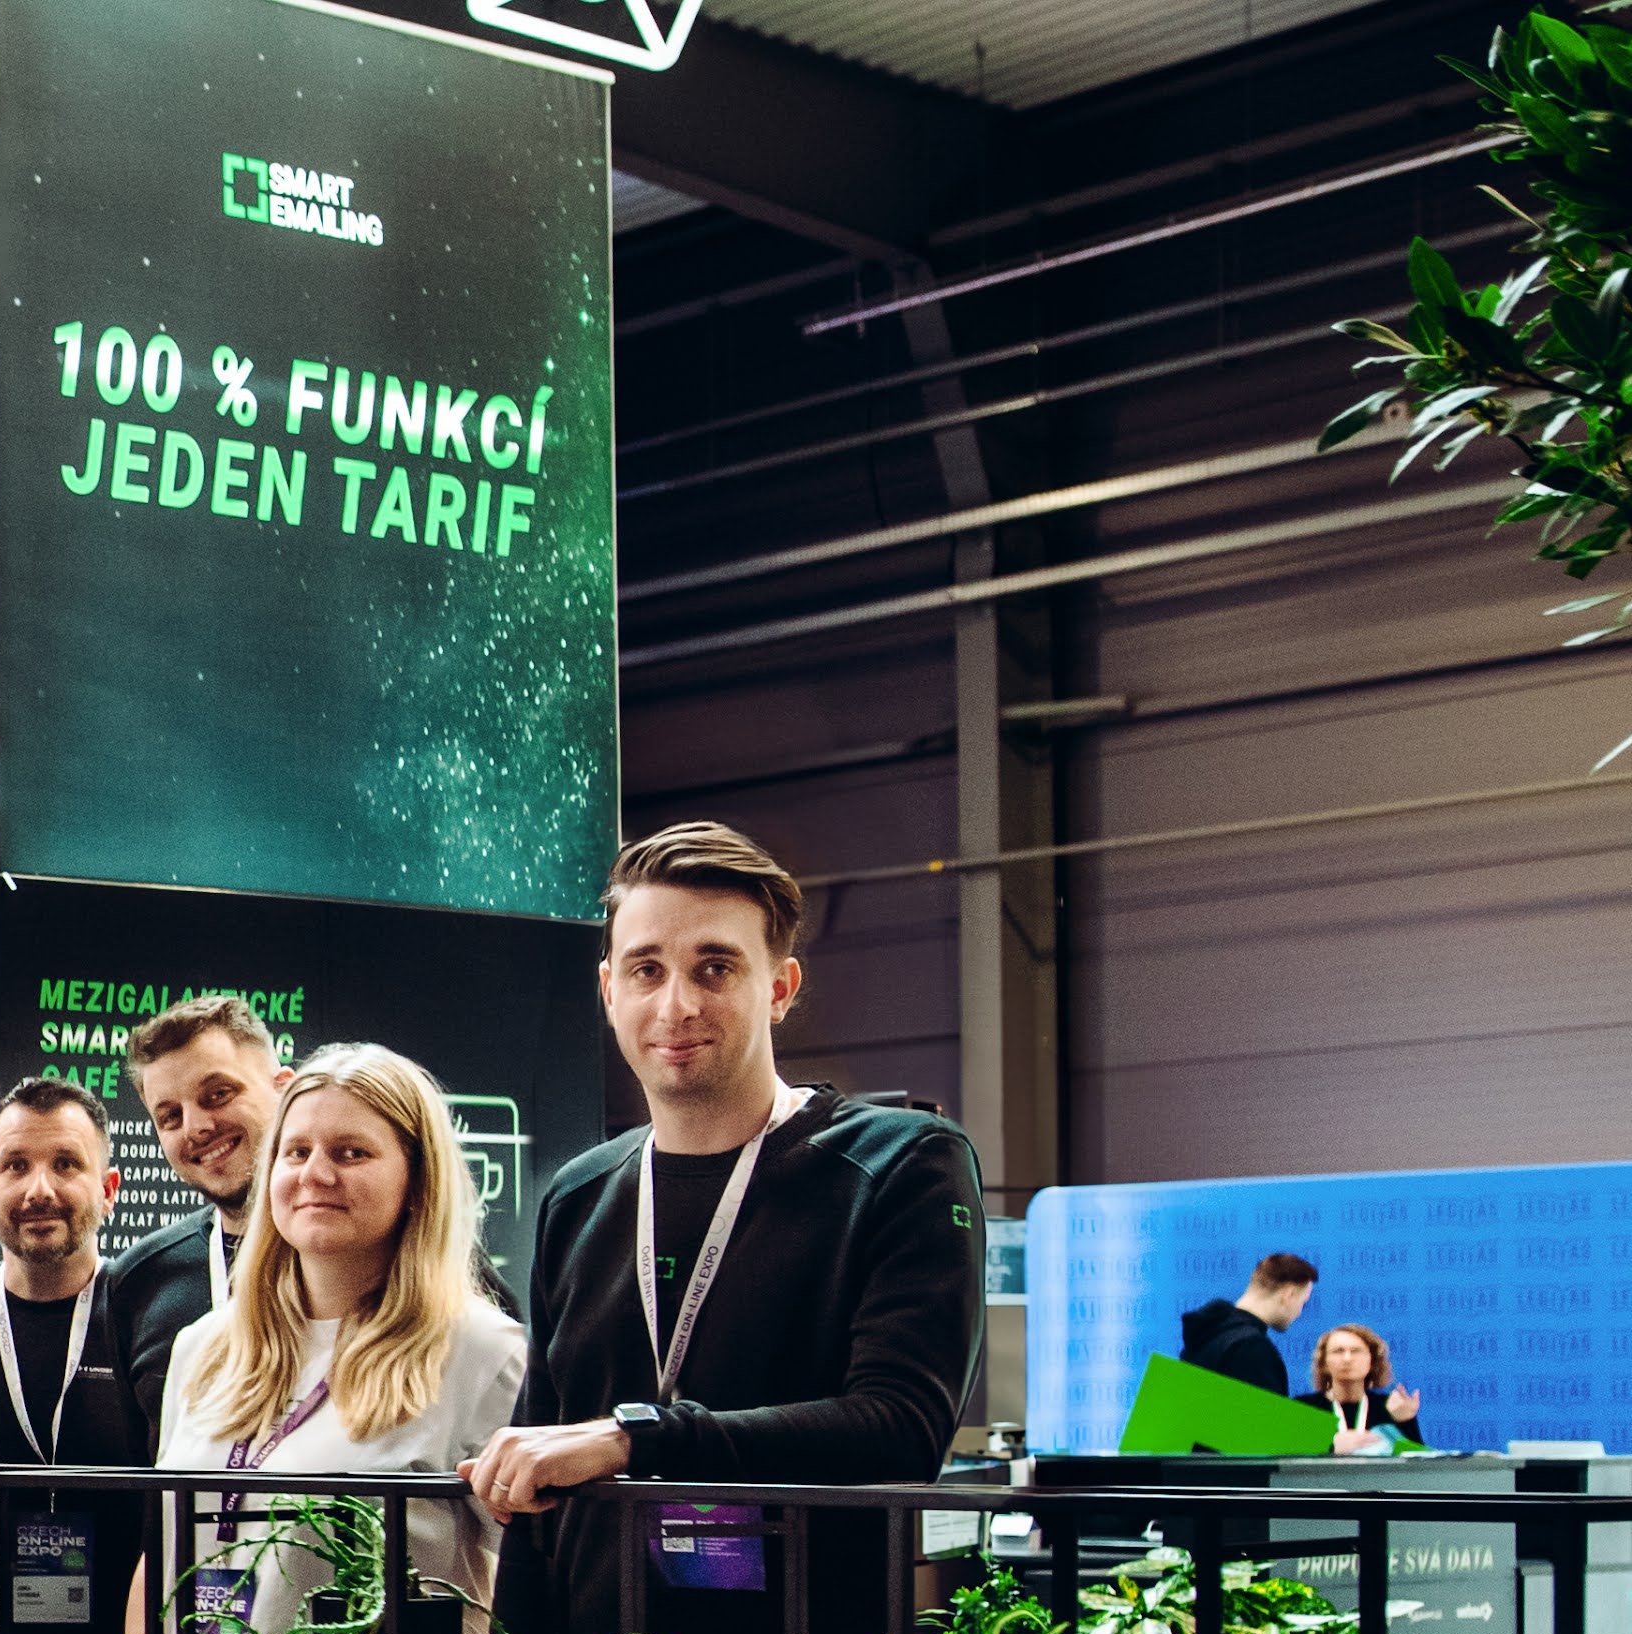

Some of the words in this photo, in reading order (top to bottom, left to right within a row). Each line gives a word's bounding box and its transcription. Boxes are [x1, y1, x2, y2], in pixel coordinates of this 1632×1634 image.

[269, 162, 354, 208] SMART
[269, 193, 383, 246] EMAILING
[53, 320, 183, 413] 100
[211, 345, 258, 427] %
[285, 358, 554, 475] FUNKCÍ
[61, 418, 307, 526] JEDEN
[333, 456, 536, 557] TARIF
[109, 1120, 152, 1136] MICKÉ
[120, 1144, 165, 1159] DOUBL
[121, 1212, 154, 1227] FLAT
[229, 1443, 247, 1468] XPO
[252, 1440, 277, 1467] EXPO
[17, 1526, 71, 1537] CZECH
[17, 1536, 86, 1547] ON-LINE
[17, 1546, 63, 1556] EXPO
[1447, 1543, 1495, 1573] DATA
